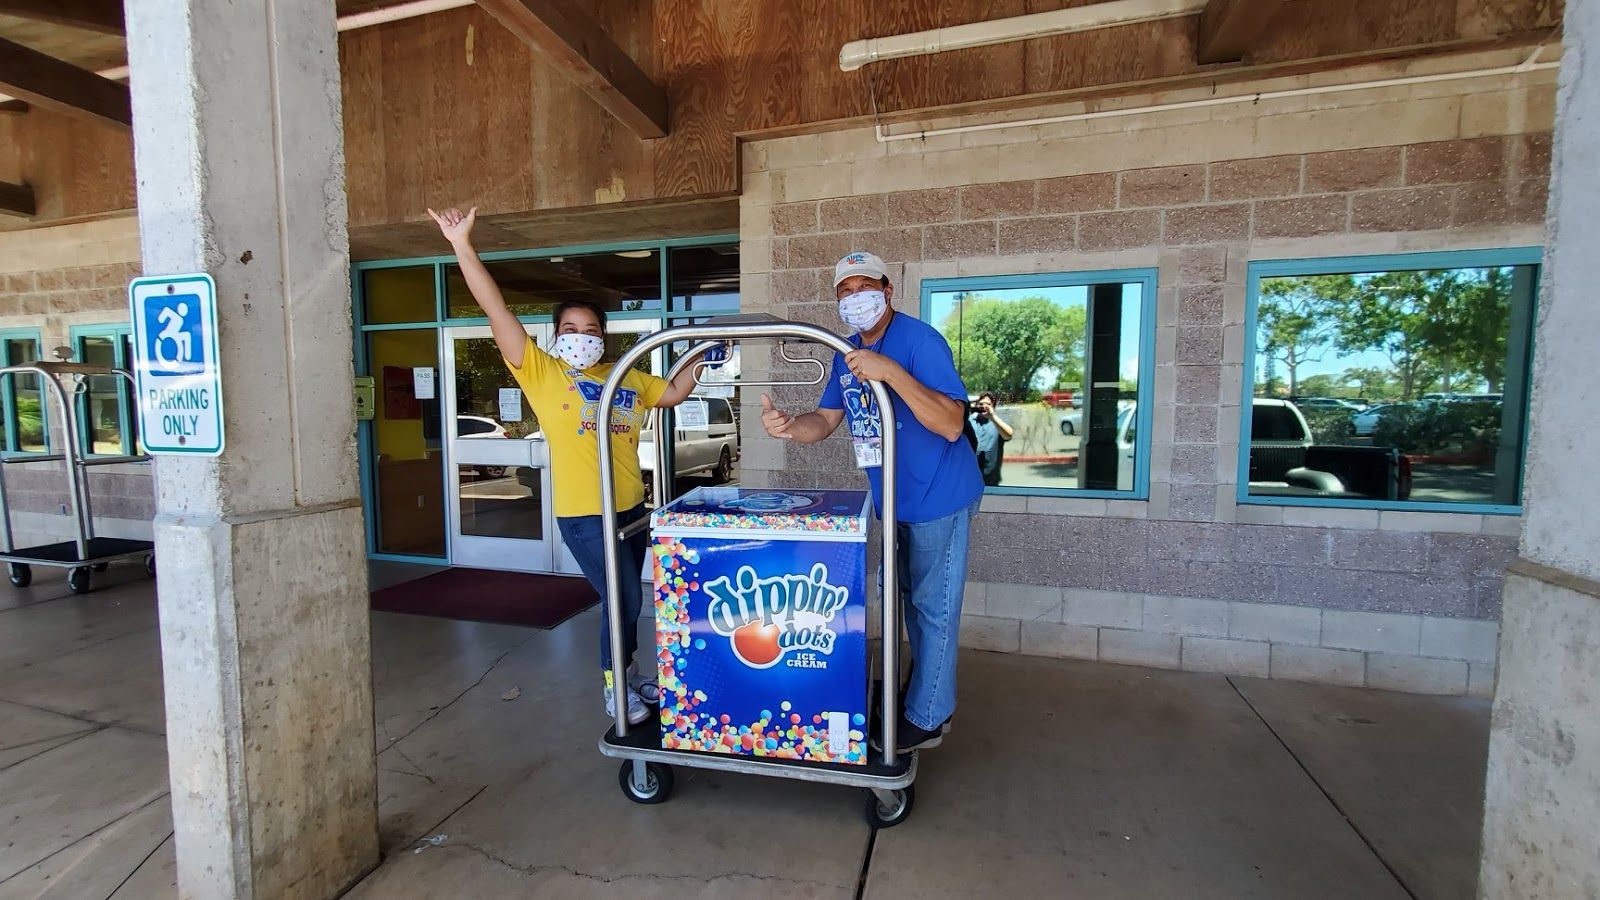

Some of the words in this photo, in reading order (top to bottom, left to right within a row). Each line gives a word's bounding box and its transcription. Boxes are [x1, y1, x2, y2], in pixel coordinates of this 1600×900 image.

[149, 388, 209, 410] PARKING
[162, 414, 199, 436] ONLY
[778, 621, 832, 649] dots
[786, 659, 827, 669] CREAM
[796, 652, 816, 661] ICE
